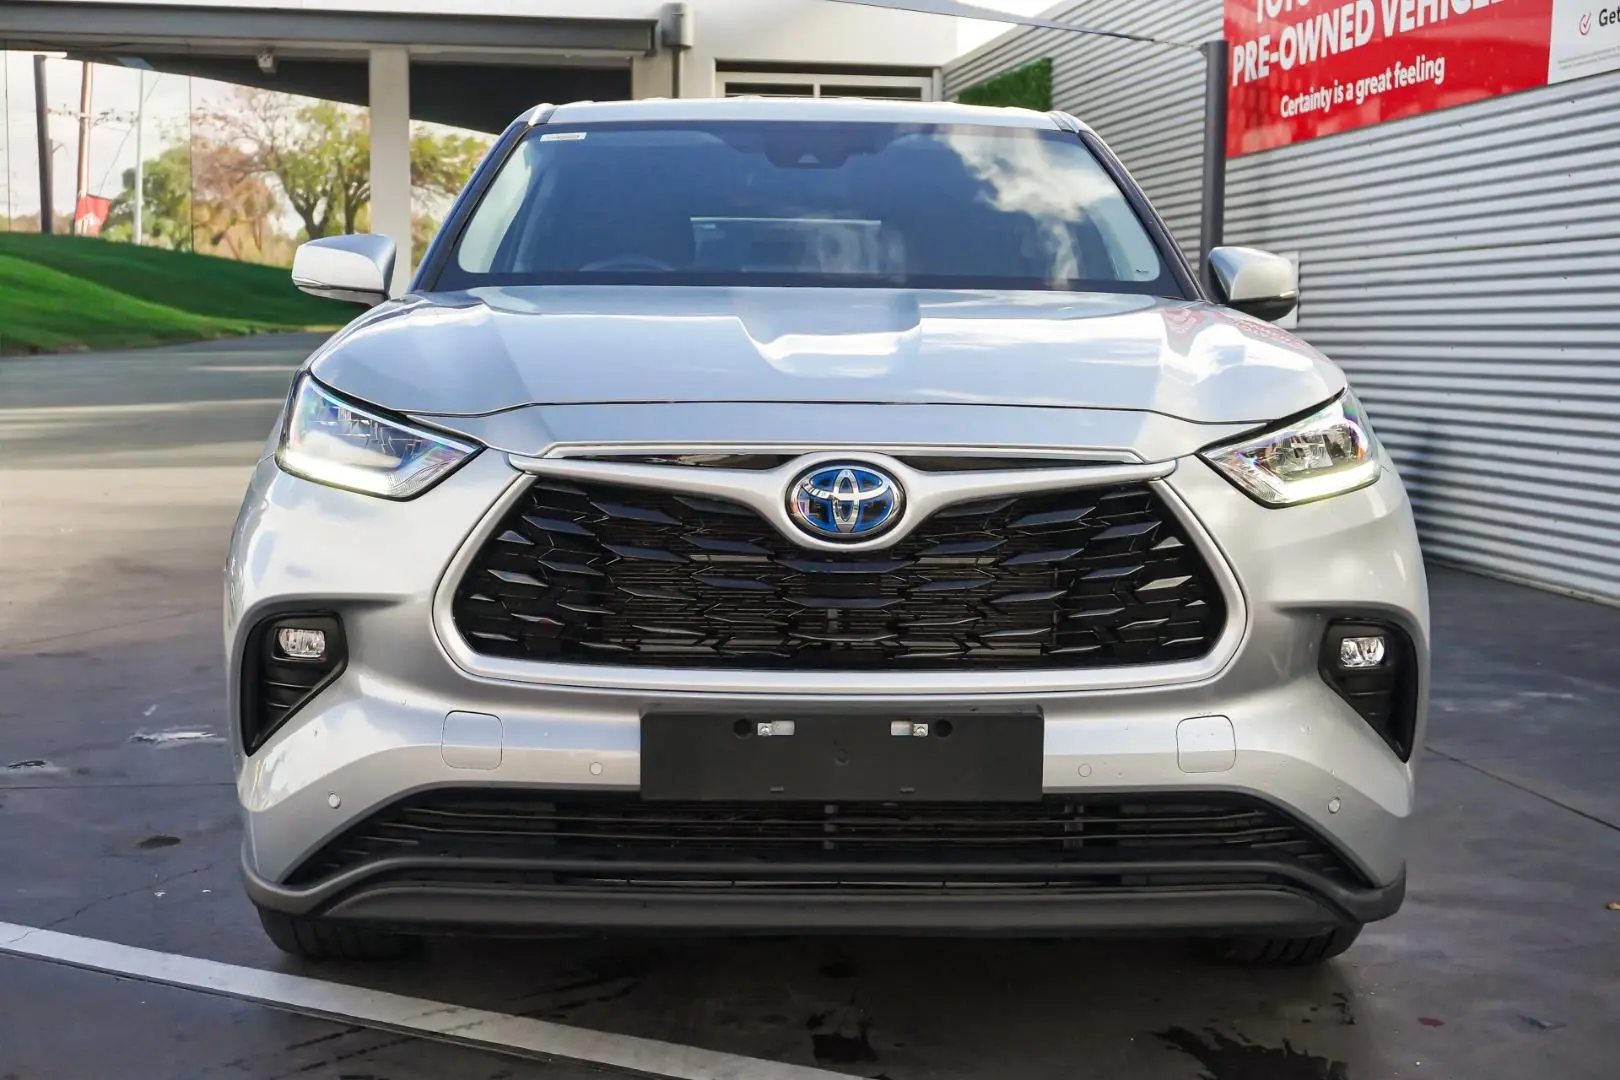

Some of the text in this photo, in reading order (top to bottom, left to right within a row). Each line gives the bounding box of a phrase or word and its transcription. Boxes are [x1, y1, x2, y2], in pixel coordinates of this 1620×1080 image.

[1232, 0, 1375, 87] PRE-OWNED
[1280, 54, 1445, 118] Certainty is a great feeling
